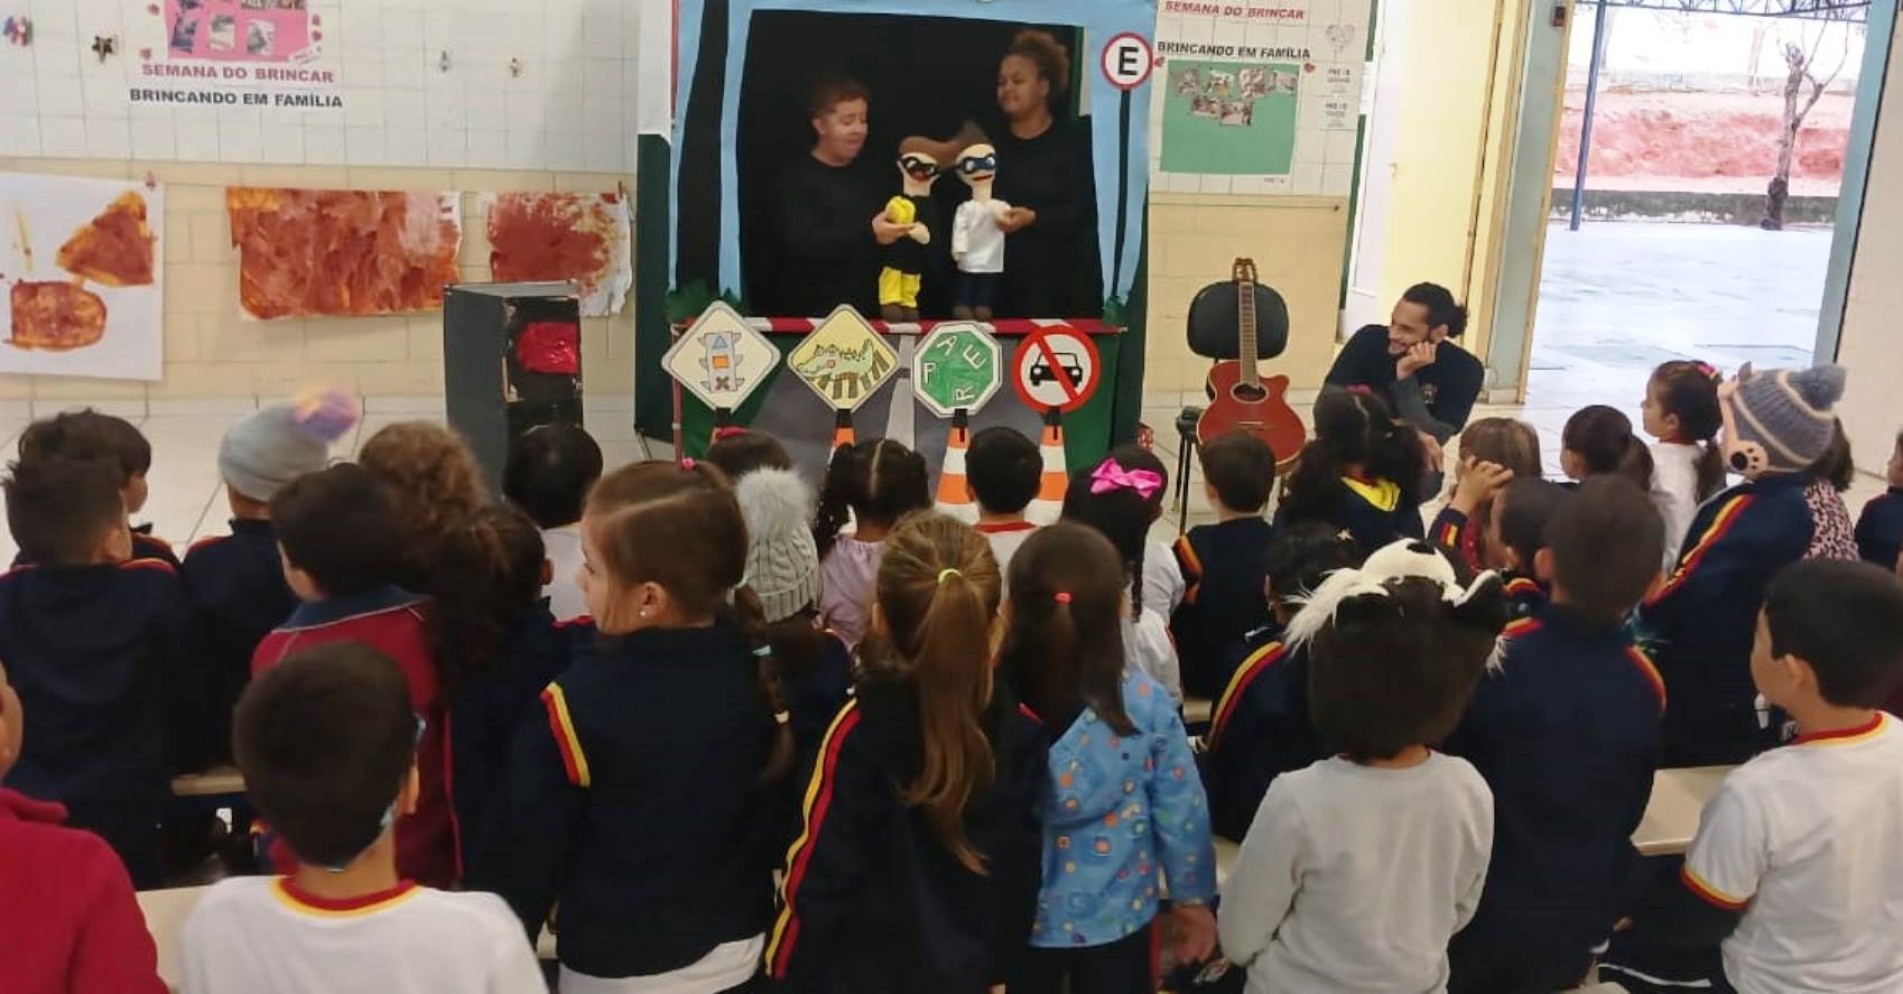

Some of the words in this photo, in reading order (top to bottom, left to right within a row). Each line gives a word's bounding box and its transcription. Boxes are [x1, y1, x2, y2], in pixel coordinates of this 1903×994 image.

[1166, 0, 1219, 14] SEMANA
[1224, 6, 1243, 16] DO
[1247, 7, 1304, 19] BRINCAR
[1157, 41, 1234, 56] BRINCANDO
[1237, 46, 1256, 57] EM
[1260, 46, 1310, 59] FAMÍLIA
[1118, 46, 1139, 76] E
[142, 64, 217, 78] SEMANA
[222, 66, 247, 79] DO
[255, 68, 334, 82] BRINCAR
[130, 88, 237, 104] BRINCANDO
[243, 93, 268, 105] EM
[274, 93, 343, 108] FAMÍLIA
